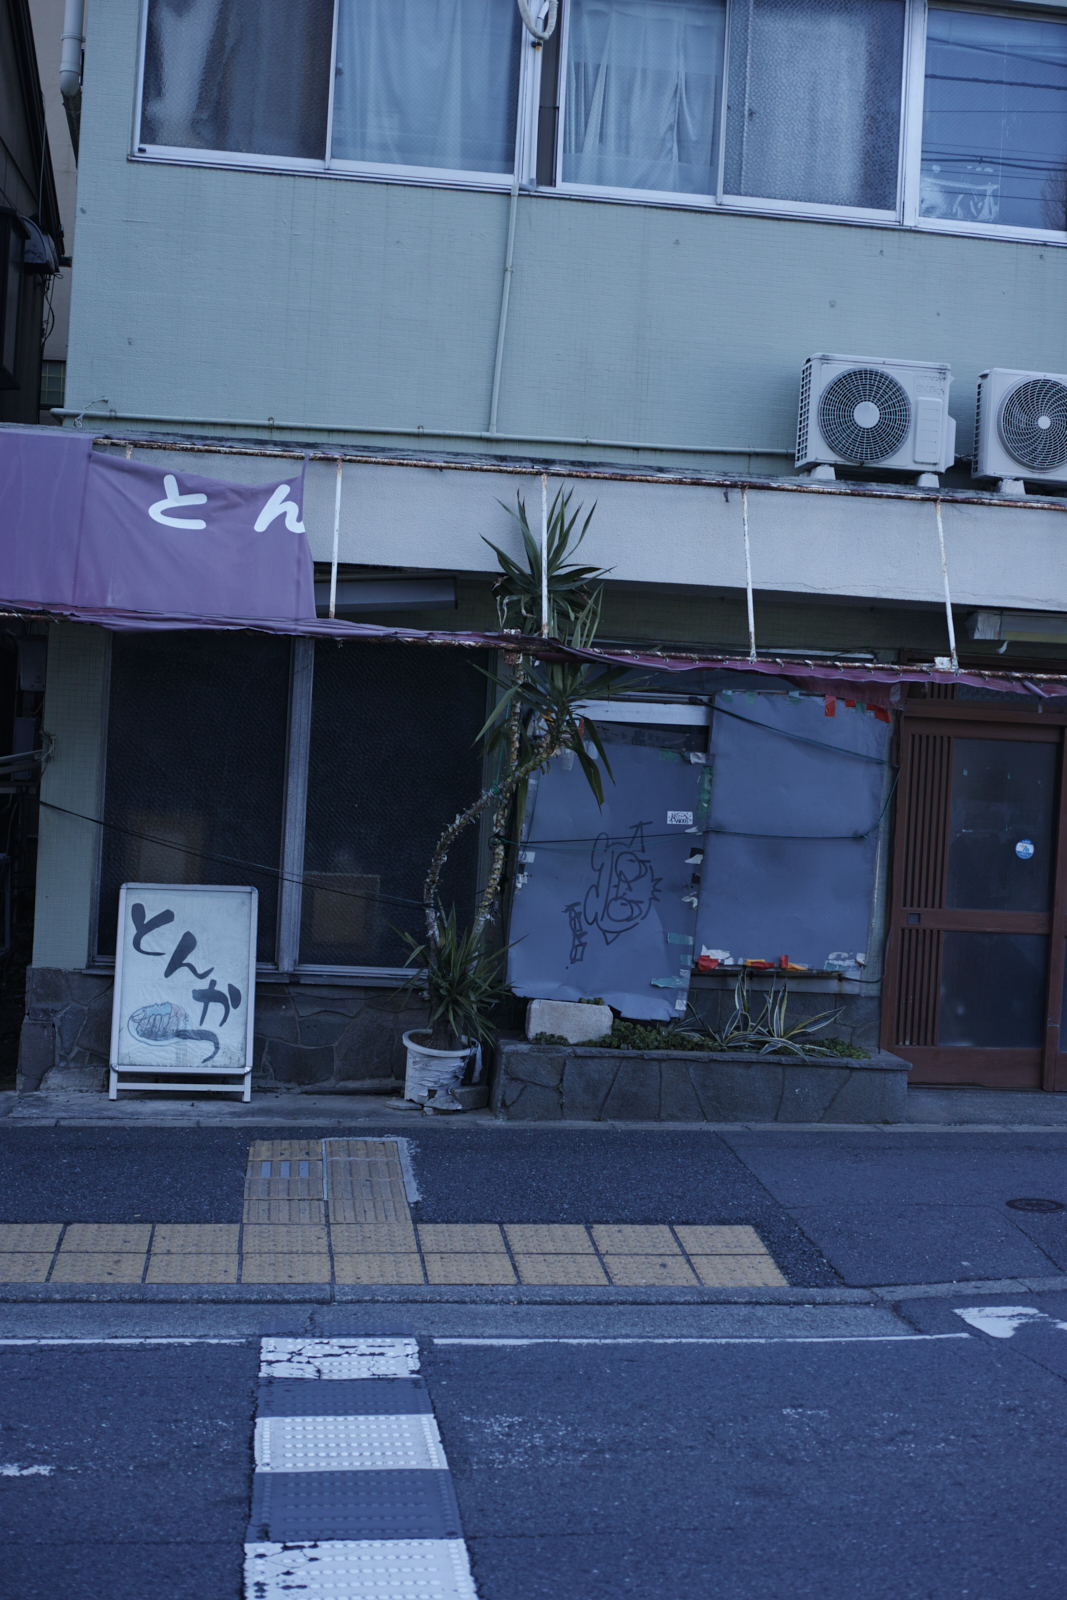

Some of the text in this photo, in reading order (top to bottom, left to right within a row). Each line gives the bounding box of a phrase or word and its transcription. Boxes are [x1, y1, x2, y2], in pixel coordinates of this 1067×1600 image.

[148, 474, 305, 534] とん
[131, 902, 242, 1064] とんかつ
